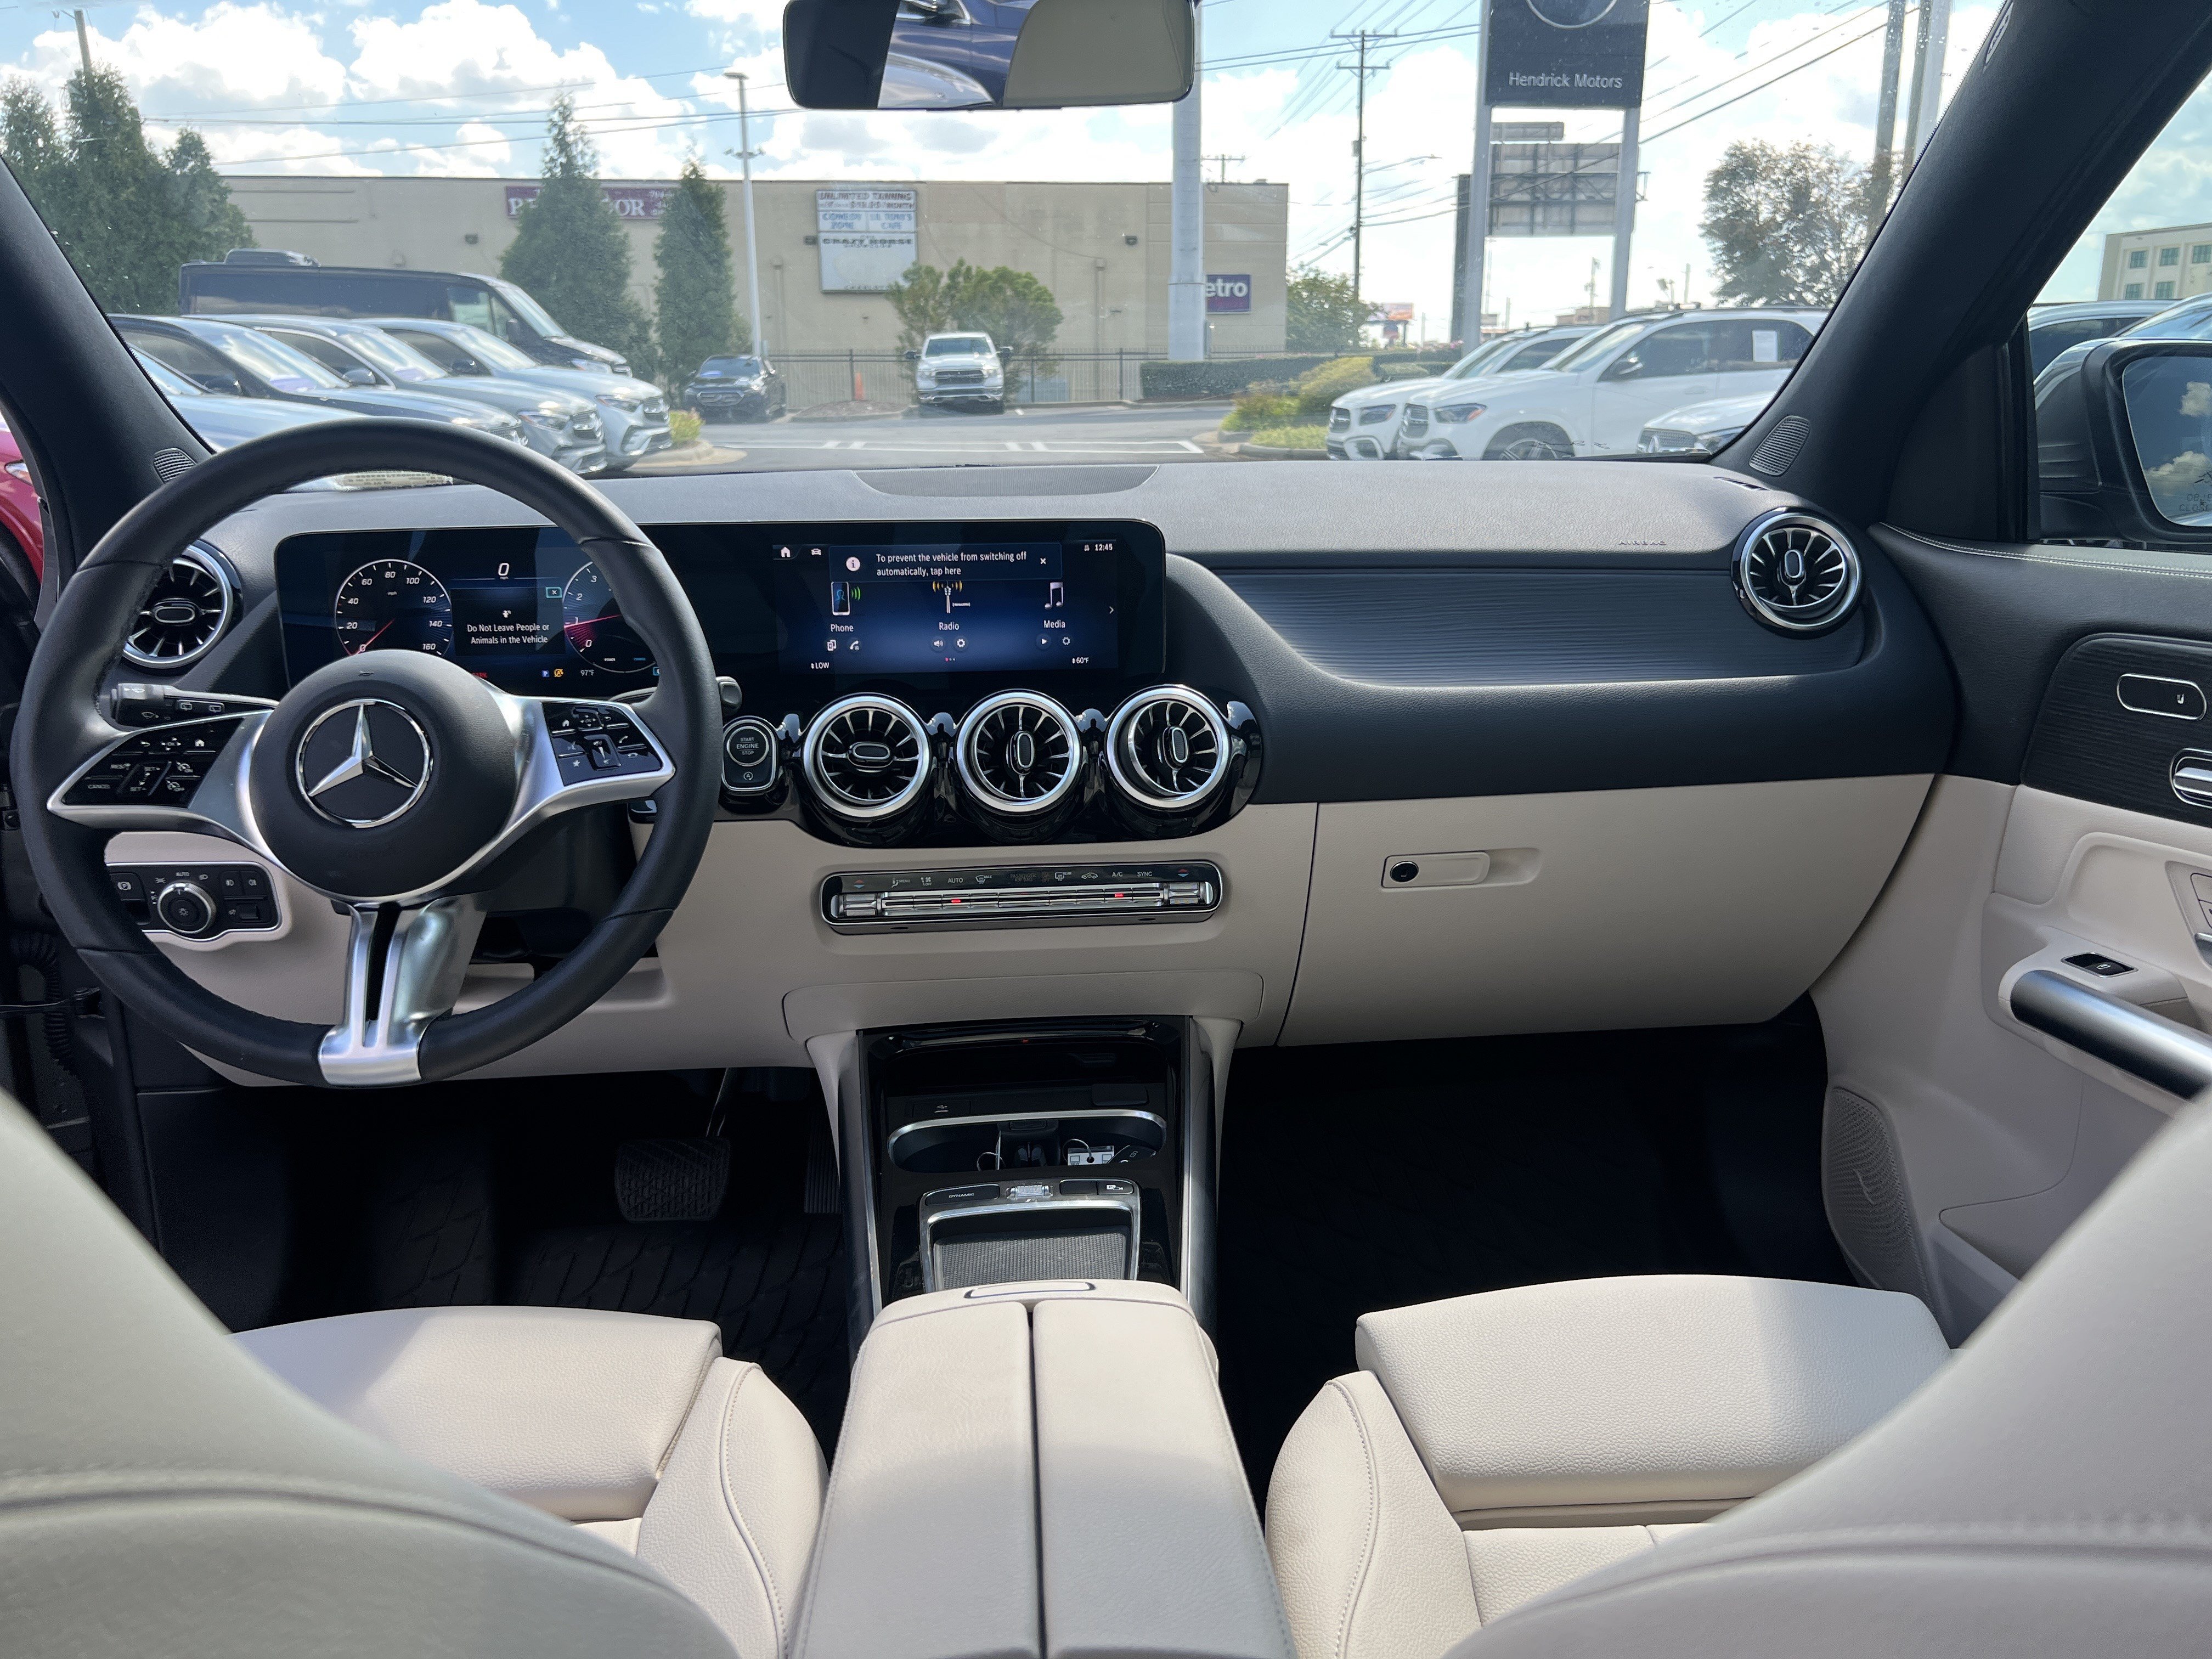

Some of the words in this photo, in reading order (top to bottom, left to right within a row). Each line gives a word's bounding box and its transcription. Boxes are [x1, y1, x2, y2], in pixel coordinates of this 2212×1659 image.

[1509, 72, 1571, 87] Hendrick
[1574, 74, 1622, 88] Motors
[1205, 278, 1248, 297] etro
[876, 554, 885, 562] To
[888, 555, 916, 565] prevent
[918, 554, 930, 562] the
[932, 552, 958, 561] vehicle
[961, 552, 978, 561] from
[980, 552, 1014, 562] switching
[1016, 551, 1026, 560] off
[498, 562, 510, 577] 0
[877, 567, 929, 577] automatically,
[930, 568, 943, 577] tap
[945, 567, 961, 575] here
[516, 623, 540, 633] People
[831, 623, 854, 632] Phone
[939, 622, 960, 630] Radio
[1044, 620, 1065, 628] Media
[522, 635, 548, 643] Vehicle
